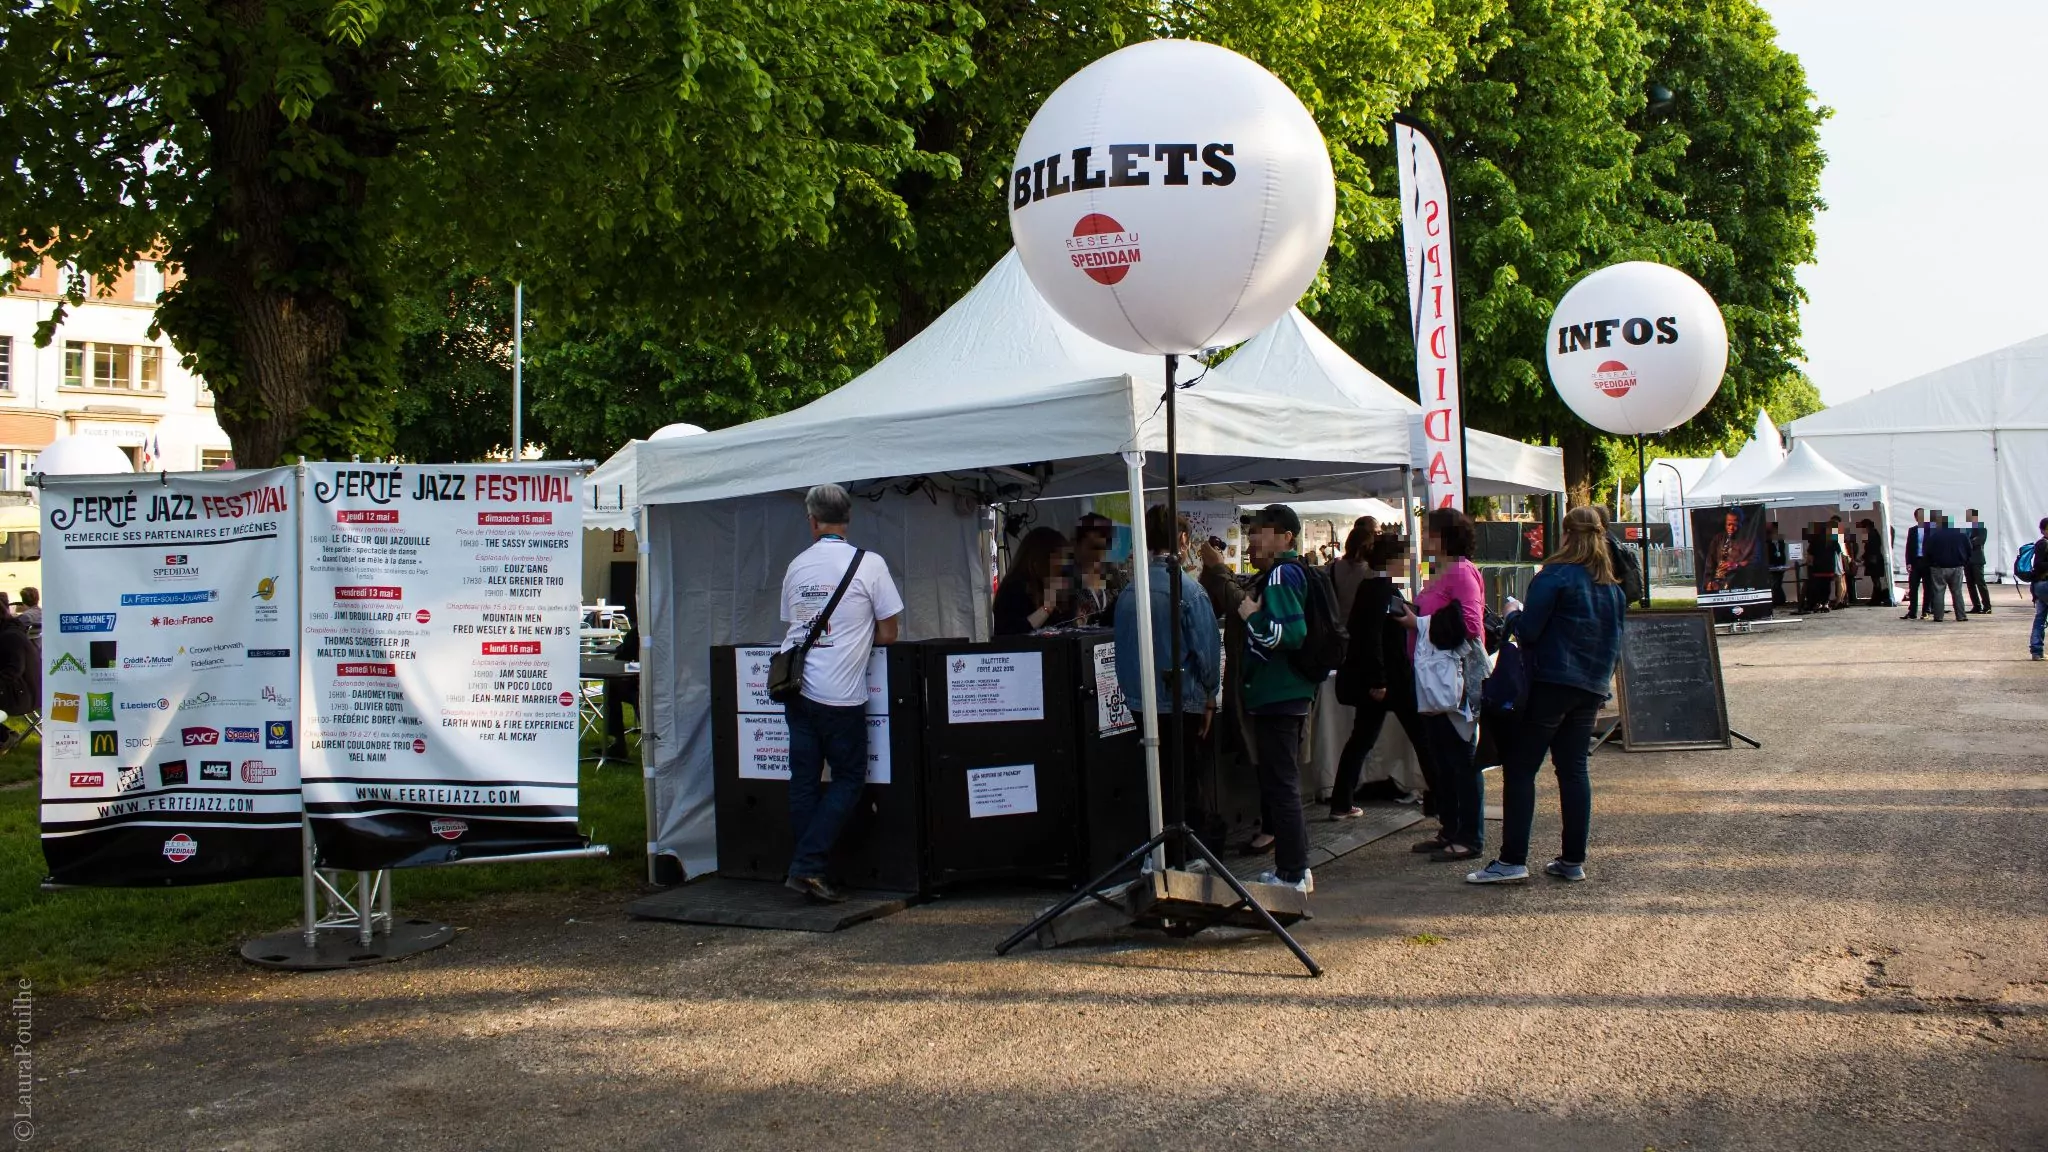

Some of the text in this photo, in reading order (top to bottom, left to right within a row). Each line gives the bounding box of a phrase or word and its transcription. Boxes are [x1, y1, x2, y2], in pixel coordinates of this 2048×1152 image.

[1014, 143, 1237, 211] BILLETS
[1066, 232, 1139, 248] RESEAU
[1071, 248, 1141, 268] SPEDIDAM
[1559, 317, 1679, 354] INFOS
[1594, 379, 1637, 389] SPEDIDAM
[315, 467, 572, 504] FERTÉ JAZZ FESTIVAL
[51, 486, 288, 530] FERTÉ JAZZ FESTIVAL
[346, 512, 390, 522] jeudi 12 mai
[486, 514, 545, 523] dimanche 15 mai
[65, 522, 277, 542] REMERCIE SES PARTENAIRES ET MÉCÈNES
[332, 535, 339, 543] LE
[375, 536, 388, 545] QUI
[390, 536, 430, 545] JAZOUILLE
[485, 539, 569, 548] THE SASSY SWINGERS
[153, 567, 198, 576] SPEDIDAM
[488, 576, 507, 585] ALEX
[509, 577, 543, 585] GRENIER
[546, 577, 563, 585] TRIO
[341, 589, 366, 597] vendredi
[369, 589, 377, 597] 13
[510, 589, 542, 597] MIXCITY
[334, 611, 347, 620] JIMI
[349, 612, 393, 621] DROUILLARD
[482, 614, 541, 622] MOUNTAIN MEN
[453, 625, 570, 635] FRED WESLEY & THE NEW JB'S
[324, 637, 353, 646] THOMAS
[401, 639, 410, 647] JR
[317, 649, 346, 657] MALTED
[349, 649, 364, 657] MILK
[372, 650, 386, 658] TONI
[390, 651, 416, 659] GREEN
[489, 645, 533, 653] lundi 16 mai
[378, 667, 387, 675] mai
[500, 670, 548, 678] JAM SQUARE
[494, 682, 552, 690] UN POCO LOCO
[352, 690, 404, 700] DAHOMEY FUNK
[472, 694, 519, 703] JEAN-MARIE
[522, 695, 557, 704] MARRIER
[54, 697, 80, 707] fnac
[354, 702, 403, 712] OLIVIER GOTTI
[333, 714, 369, 724] FRÉDÉRIC
[372, 715, 395, 724] BOREY
[443, 719, 574, 729] EARTH WIND & FIRE EXPERIENCE
[185, 732, 217, 744] SNCF
[226, 728, 259, 742] Speedy
[499, 733, 507, 741] AL
[511, 733, 537, 741] MCKAY
[126, 739, 149, 747] SDIC
[311, 741, 410, 750] LAURENT COULONDRE TRIO
[349, 753, 386, 762] YAEL NAIM
[204, 765, 229, 774] JAZZ
[356, 787, 521, 803] WWW.FERTEJAZZ.COM
[97, 797, 254, 818] WWW.FERTEJAZZ.COM
[433, 823, 467, 832] SPEDIDAM
[163, 846, 197, 855] SPEDIDAM
